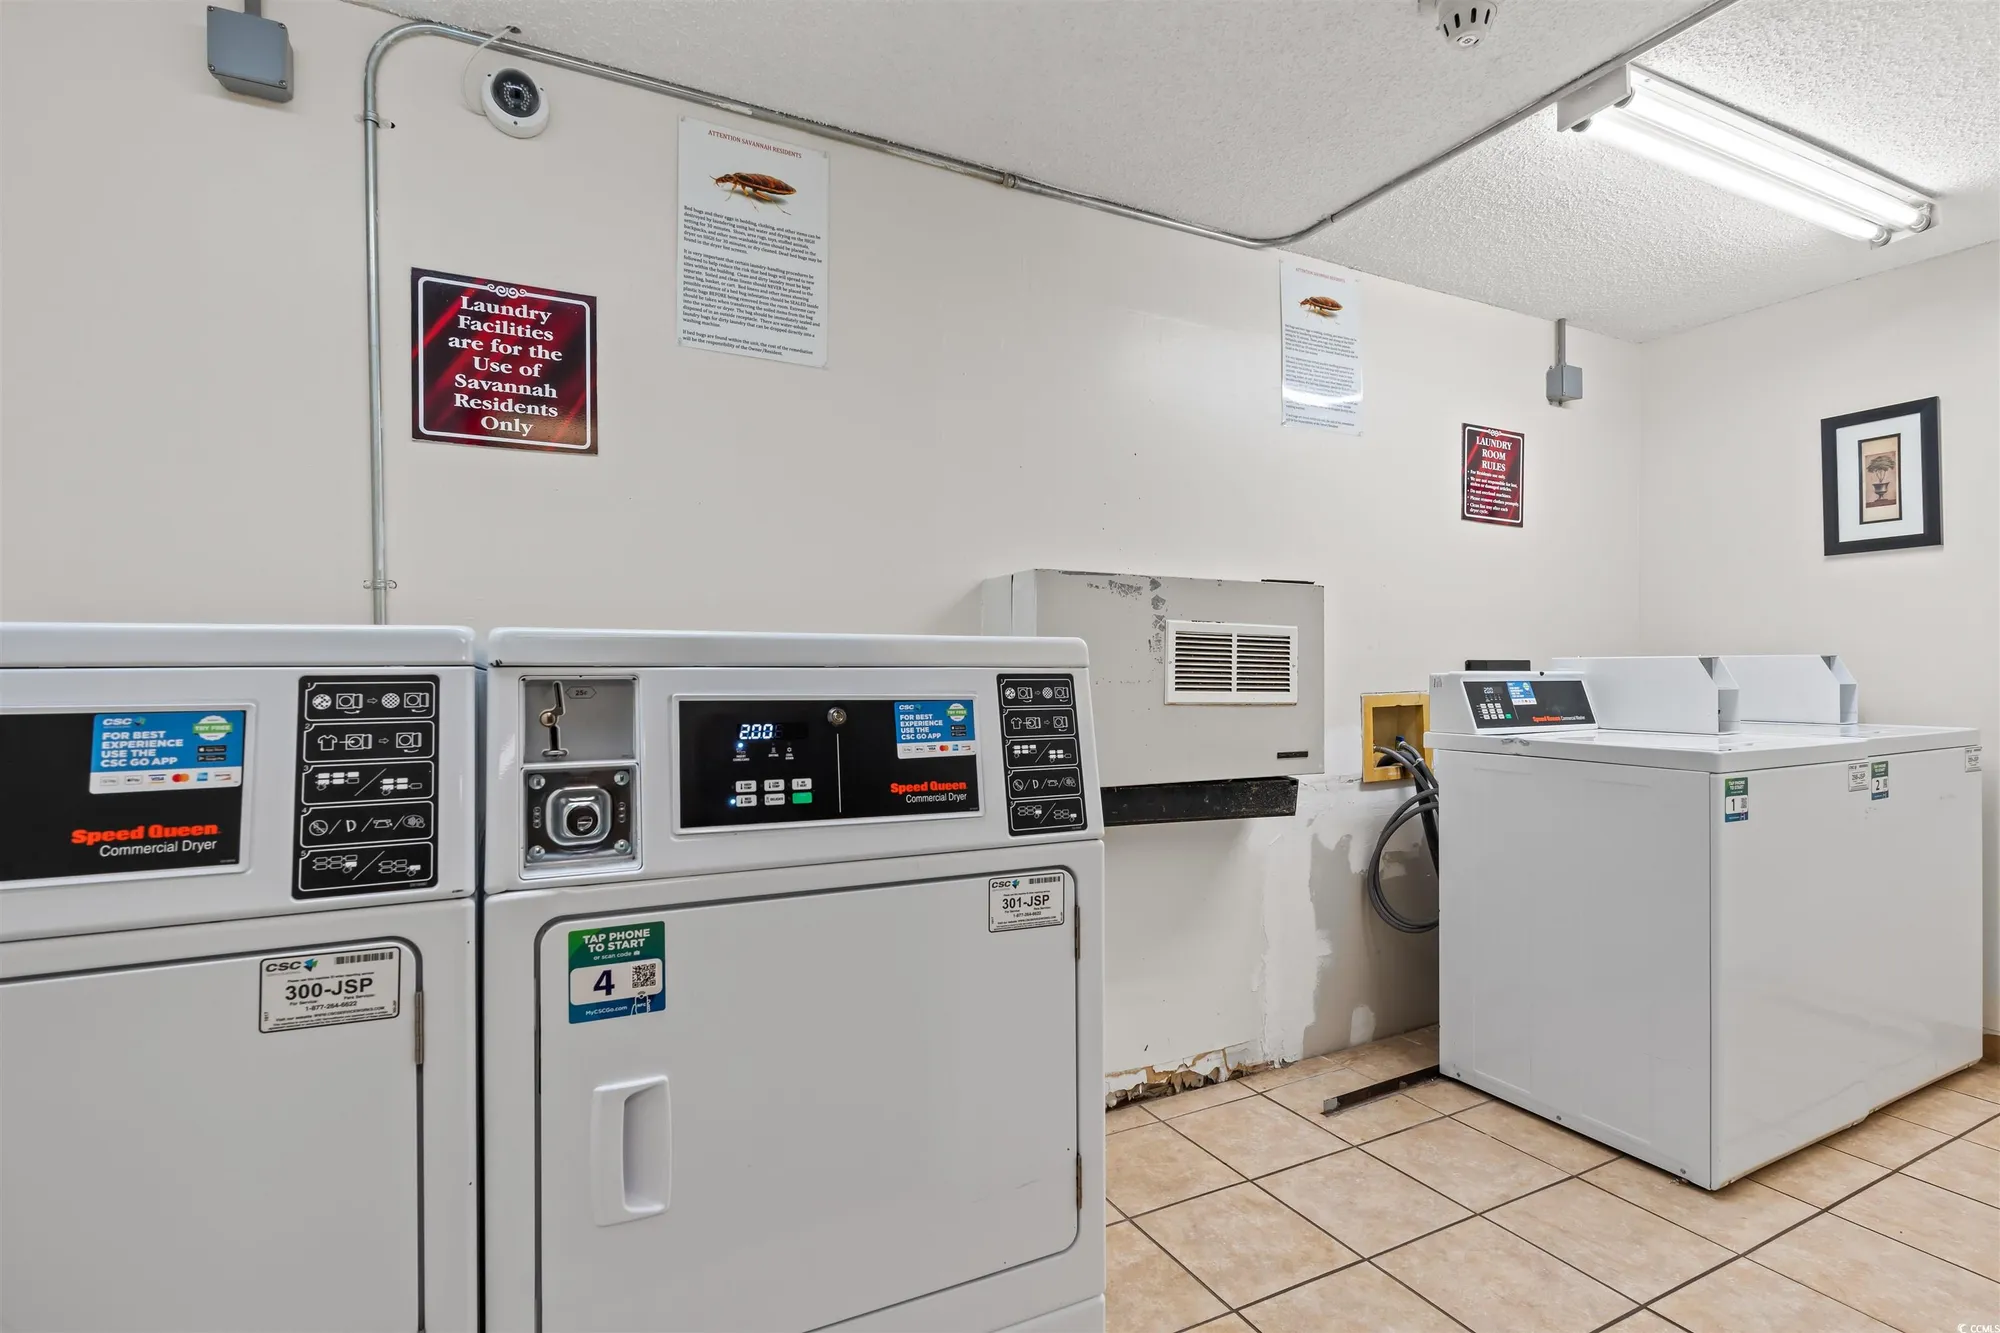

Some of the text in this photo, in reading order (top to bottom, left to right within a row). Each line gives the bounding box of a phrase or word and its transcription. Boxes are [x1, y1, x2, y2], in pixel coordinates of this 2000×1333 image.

[708, 130, 802, 158] ATTENTION SAVANNAH RESIDENTS
[461, 296, 551, 324] Laundry
[458, 315, 553, 341] Facilities
[449, 336, 562, 361] are for the
[473, 356, 543, 377] Use of
[454, 374, 558, 398] Savannah
[454, 393, 558, 417] Residents
[481, 416, 534, 436] Only
[1476, 436, 1512, 450] LAUNDRY
[1482, 449, 1506, 460] ROOM
[1482, 460, 1506, 472] RULES
[102, 718, 132, 726] CSC
[102, 731, 166, 740] FOR BEST
[740, 724, 773, 740] 2.00
[102, 739, 184, 749] EXPERIENCE
[101, 750, 128, 758] USE
[100, 757, 178, 767] CSC GO APP
[890, 781, 967, 795] Speed Queen
[1876, 780, 1880, 790] 2
[906, 792, 967, 803] Commercial Dryer
[1732, 798, 1735, 811] 1
[71, 824, 218, 846] Speed Queen
[100, 840, 217, 857] Commercial Dryer
[1002, 894, 1050, 909] 301-JSP
[583, 929, 650, 944] TAP PHONE
[588, 938, 645, 952] TO START
[265, 961, 302, 972] CSC
[285, 978, 373, 1000] 300-JSP
[593, 969, 615, 996] 4
[586, 1006, 628, 1016] MyCSCGo.com
